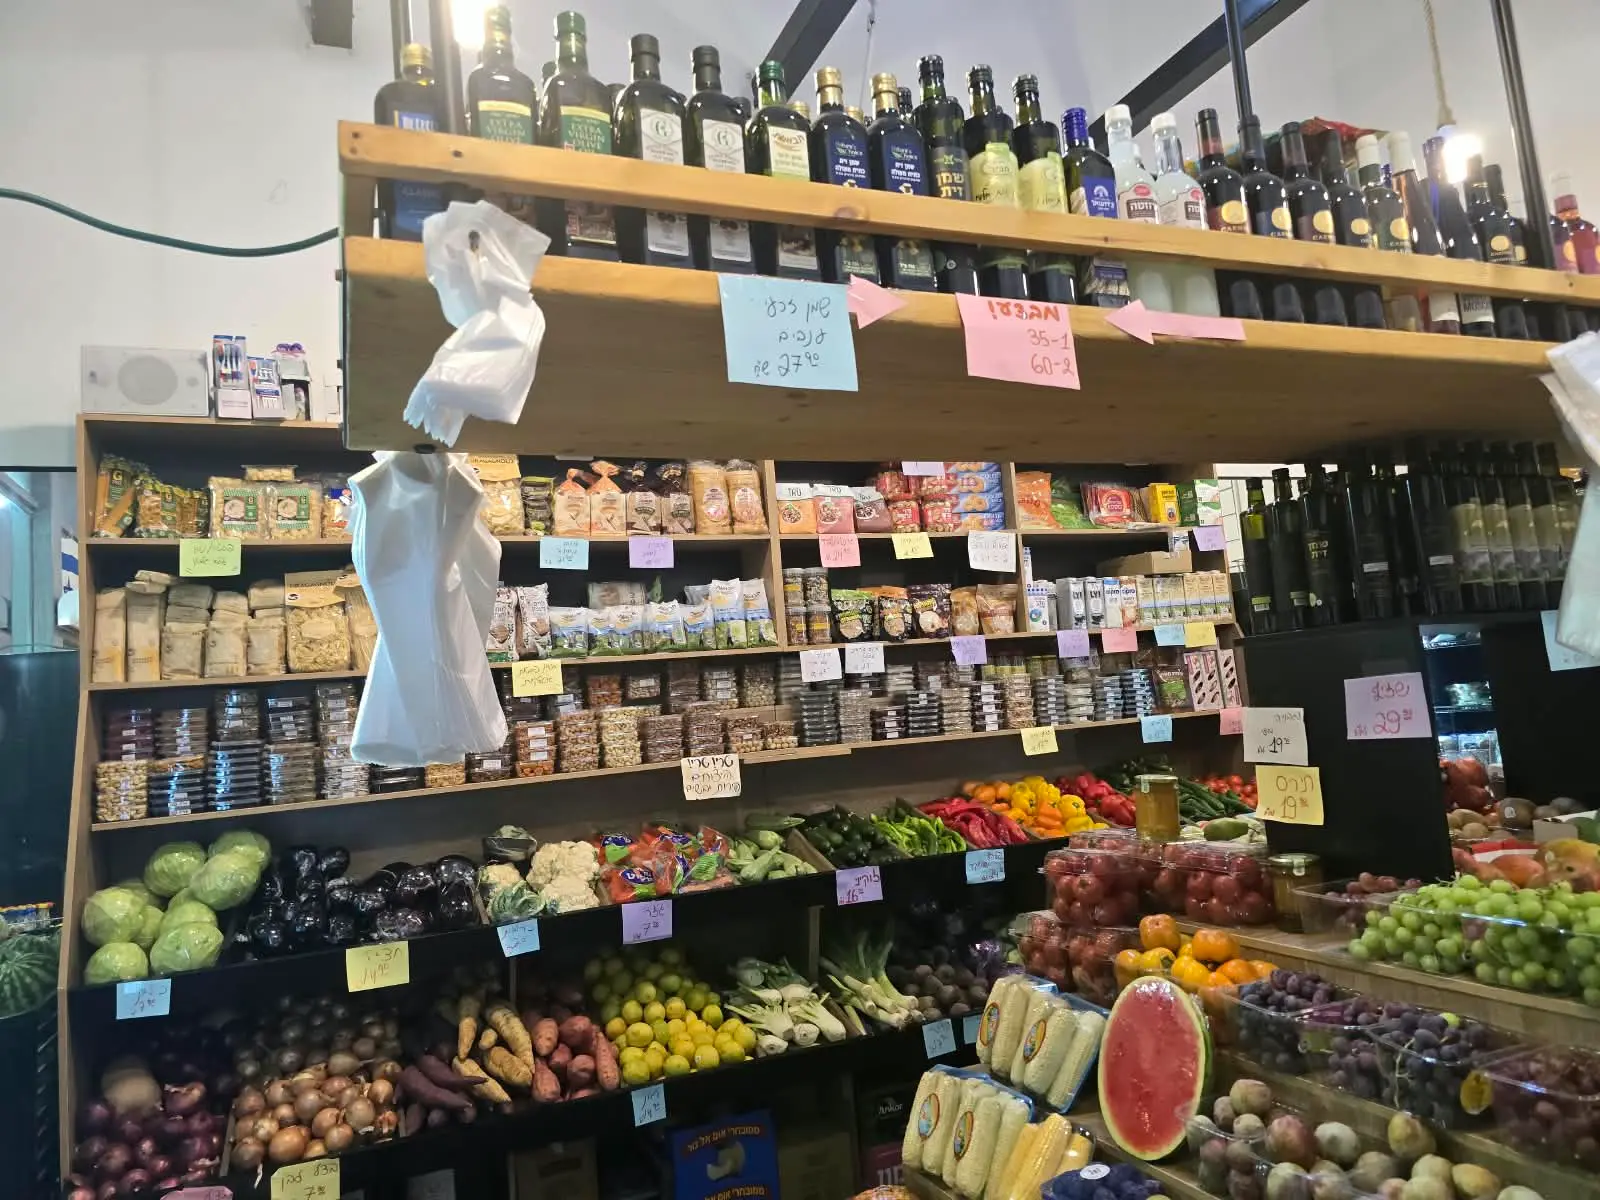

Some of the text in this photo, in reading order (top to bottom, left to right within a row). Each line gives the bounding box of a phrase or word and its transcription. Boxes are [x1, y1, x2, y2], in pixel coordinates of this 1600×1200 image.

[567, 130, 605, 143] VIRGIN
[571, 122, 602, 135] EXTRA
[936, 172, 965, 187] שמן
[940, 186, 963, 198] זית
[987, 300, 1061, 322] מבצע!
[1027, 327, 1071, 351] 35-1
[1030, 353, 1076, 378] 60-2
[1275, 774, 1315, 793] תירס
